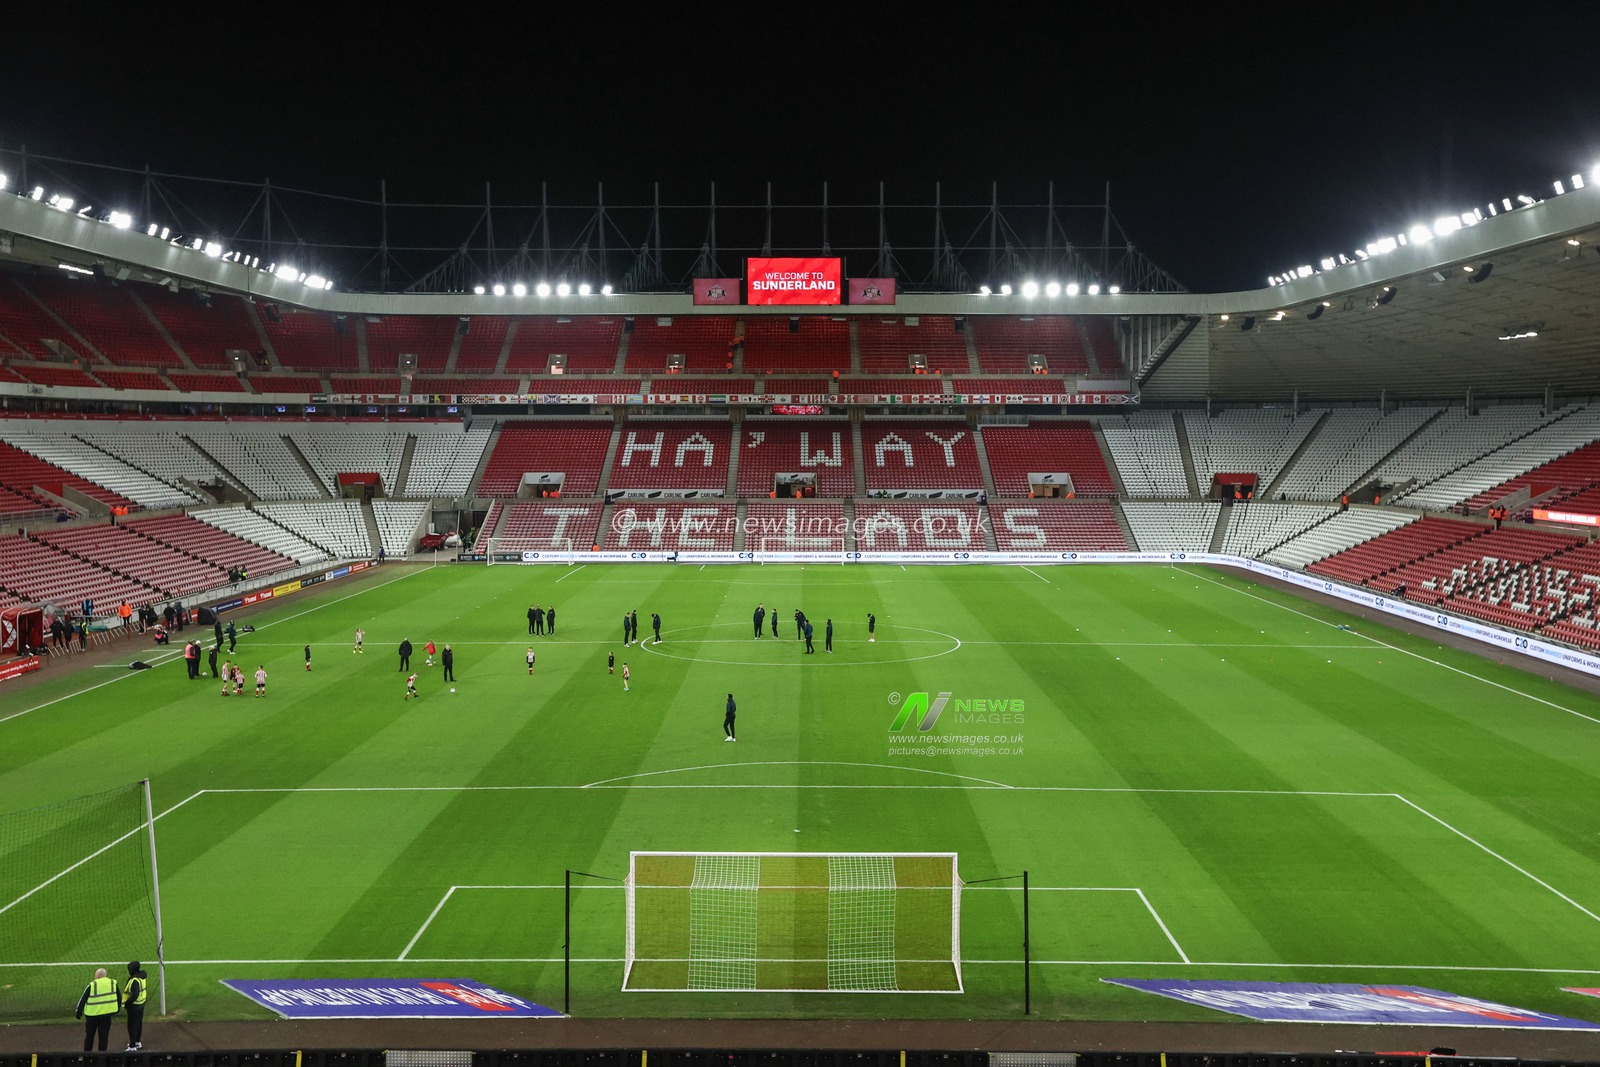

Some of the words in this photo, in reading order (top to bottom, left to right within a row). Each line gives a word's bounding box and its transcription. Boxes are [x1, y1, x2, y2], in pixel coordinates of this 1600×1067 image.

[765, 272, 810, 280] WELCOME
[812, 272, 823, 280] TO
[753, 280, 835, 290] SUNDERLAND
[543, 508, 719, 547] THE
[786, 508, 1047, 547] LADS
[1515, 637, 1529, 649] C2O
